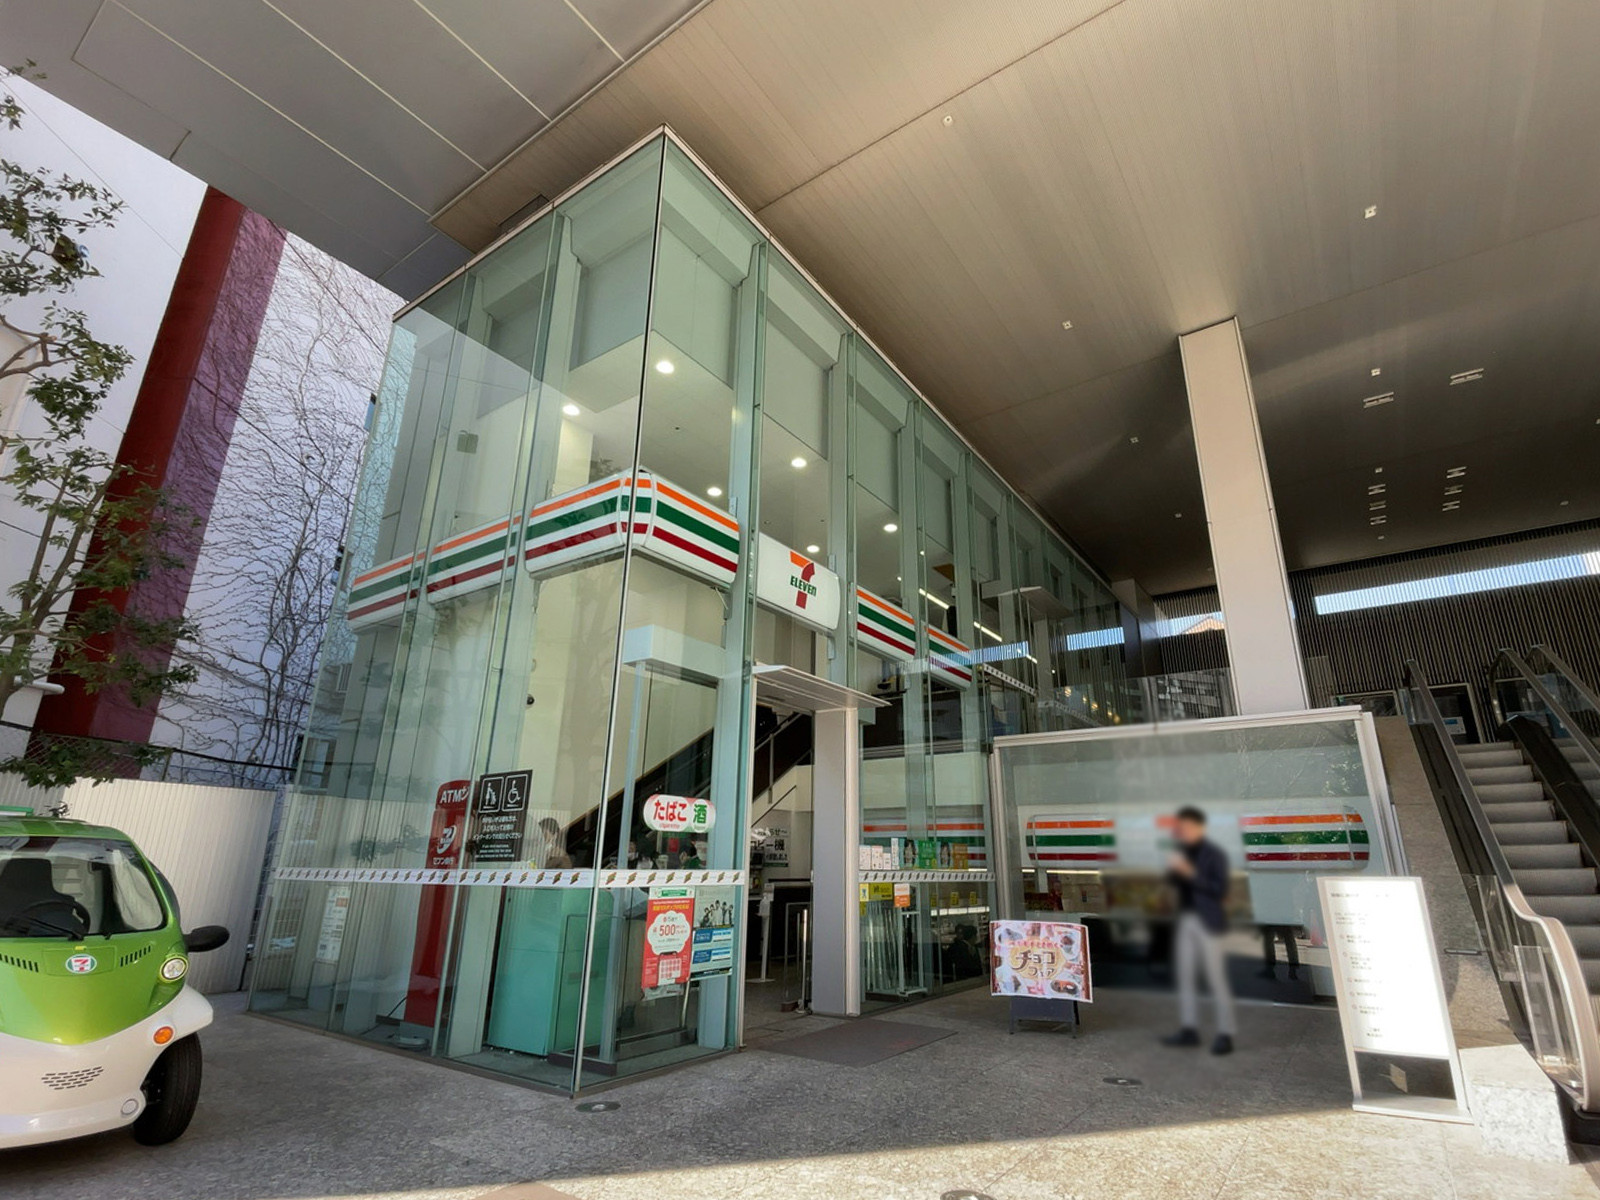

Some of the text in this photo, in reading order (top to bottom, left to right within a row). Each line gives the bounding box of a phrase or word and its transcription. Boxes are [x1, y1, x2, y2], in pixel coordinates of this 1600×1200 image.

[790, 550, 815, 610] 7
[440, 788, 462, 804] ATM
[653, 800, 708, 824] たばこ 酒
[659, 924, 676, 937] 500
[1011, 949, 1056, 971] チョコ
